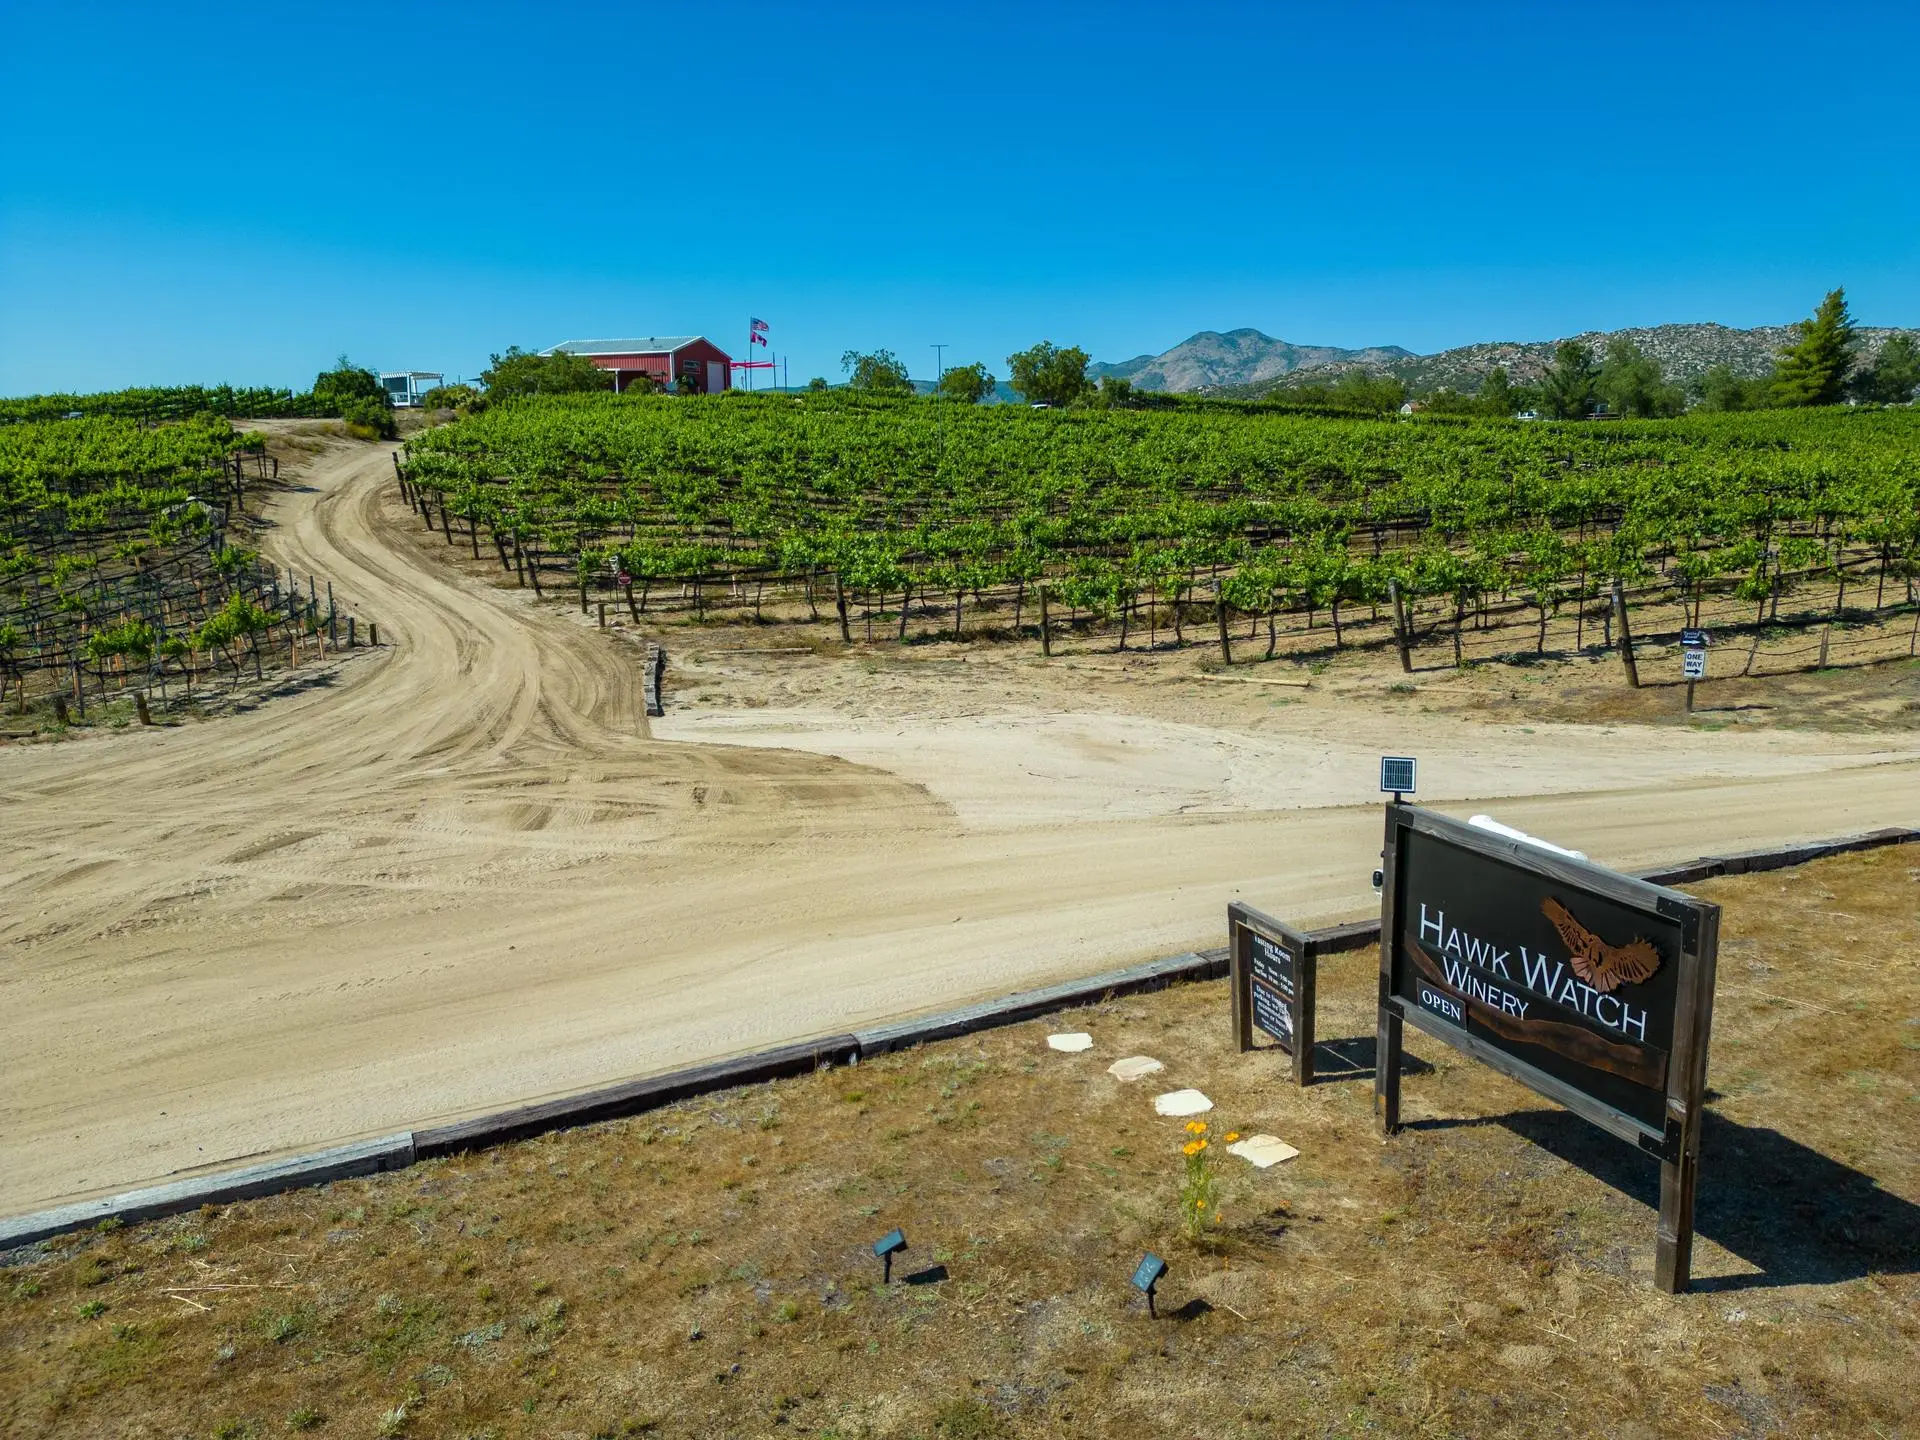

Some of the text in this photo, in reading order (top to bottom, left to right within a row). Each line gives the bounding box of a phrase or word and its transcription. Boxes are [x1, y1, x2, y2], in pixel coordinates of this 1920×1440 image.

[1419, 903, 1648, 1042] HAWK WATCH
[1442, 956, 1531, 1021] WINERY
[1422, 989, 1461, 1022] OPEN
